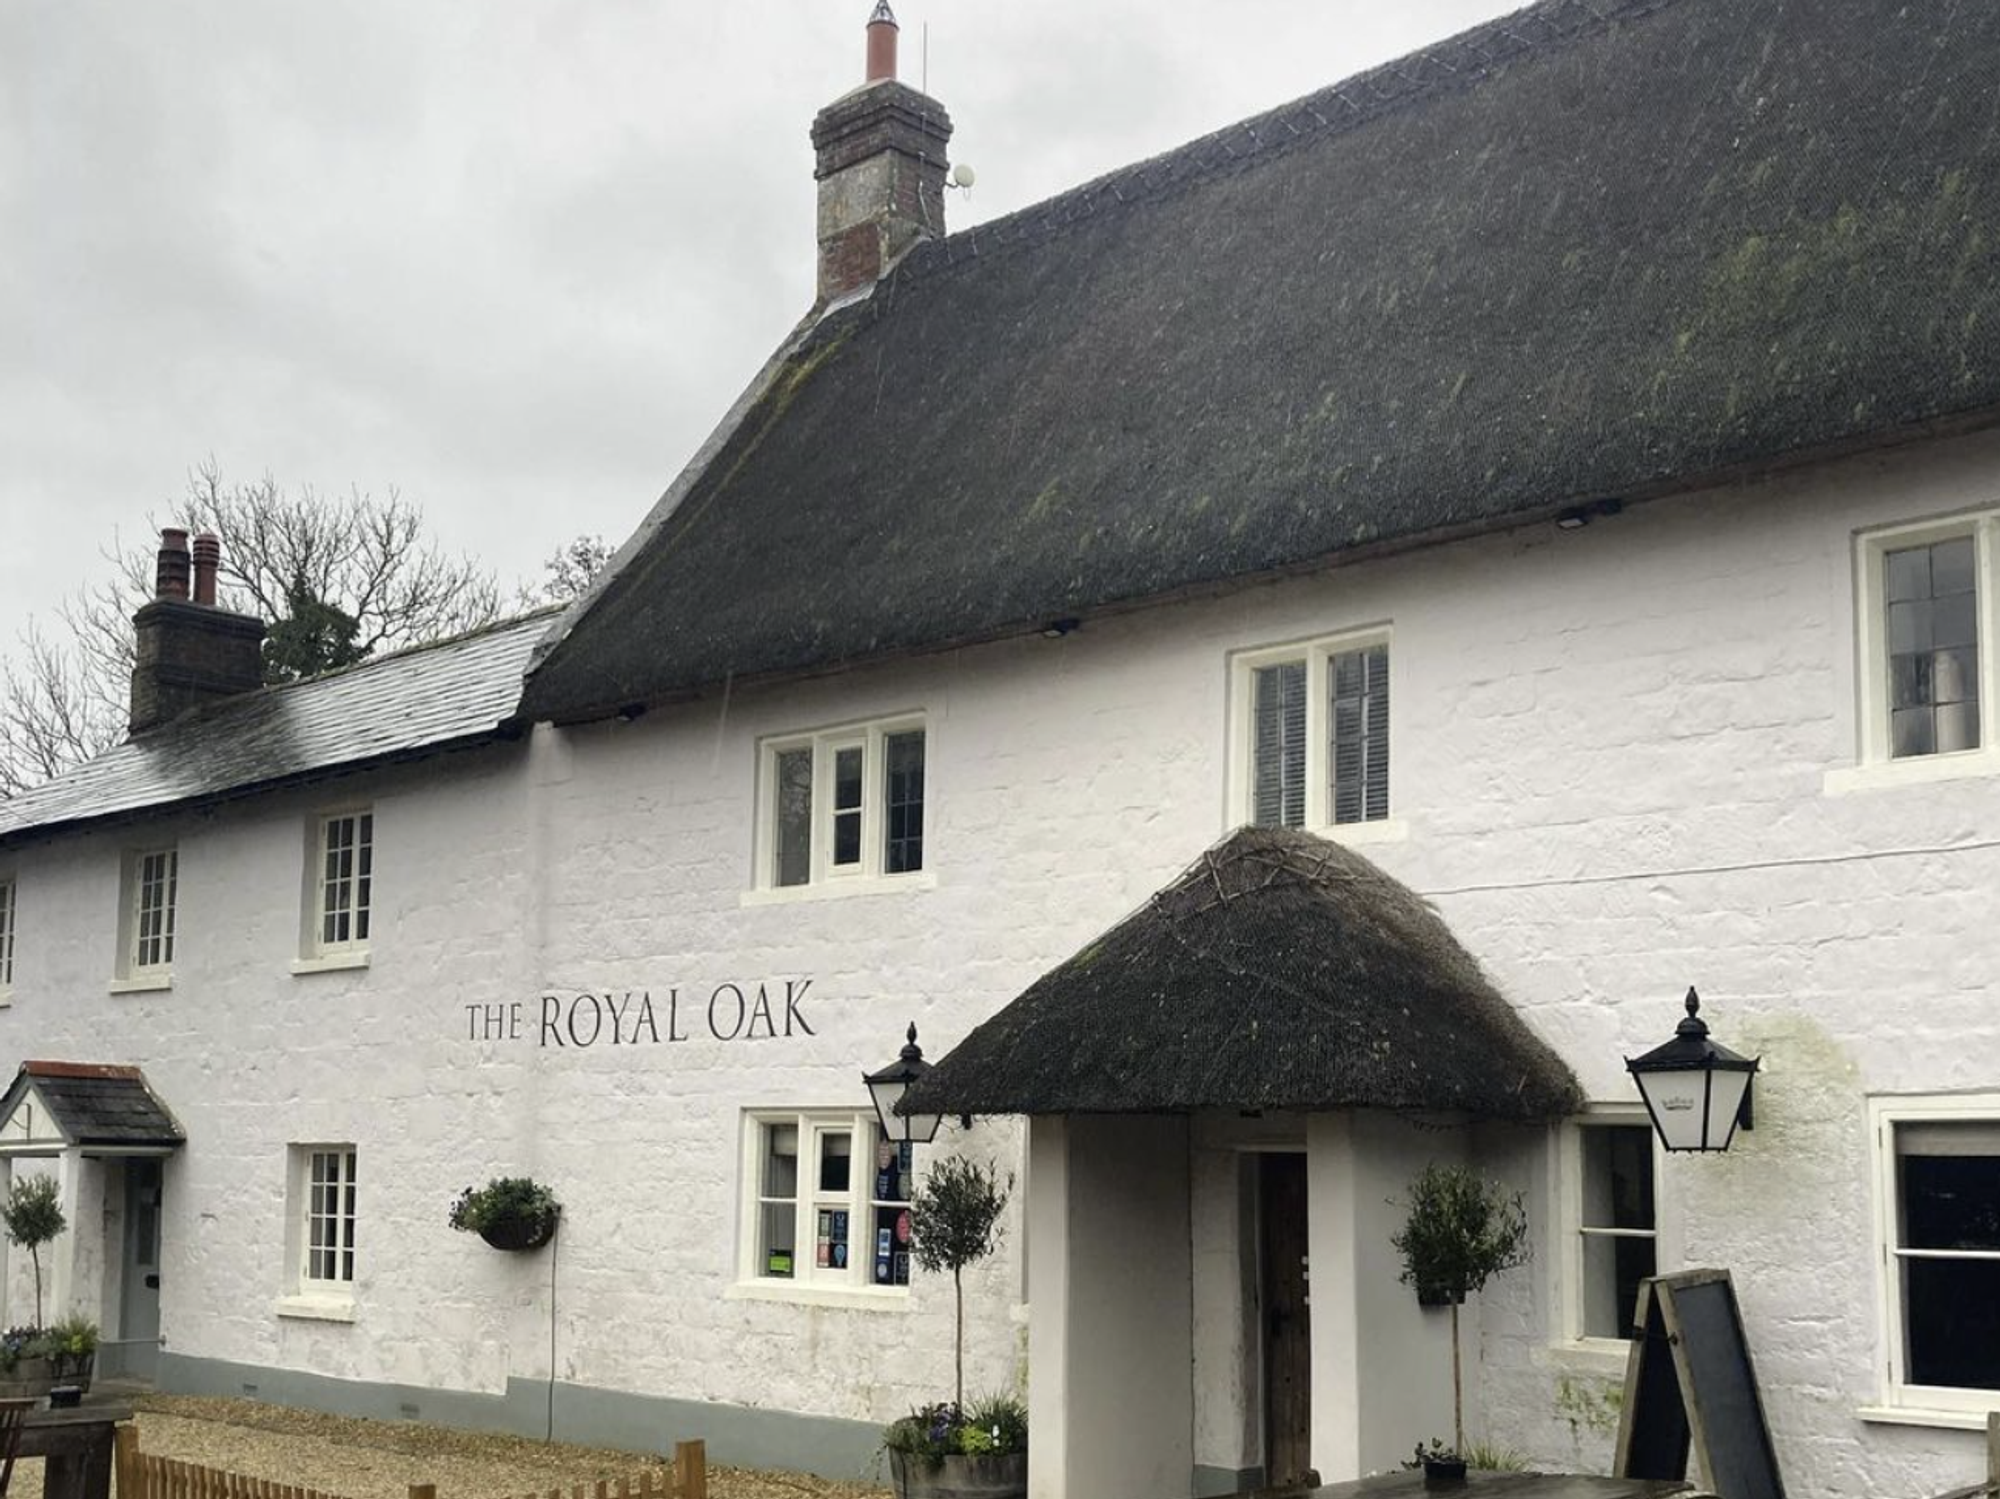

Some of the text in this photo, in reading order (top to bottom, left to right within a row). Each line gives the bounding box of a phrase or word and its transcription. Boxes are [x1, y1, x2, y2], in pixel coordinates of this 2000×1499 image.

[466, 980, 817, 1047] THE ROYAL OAK
